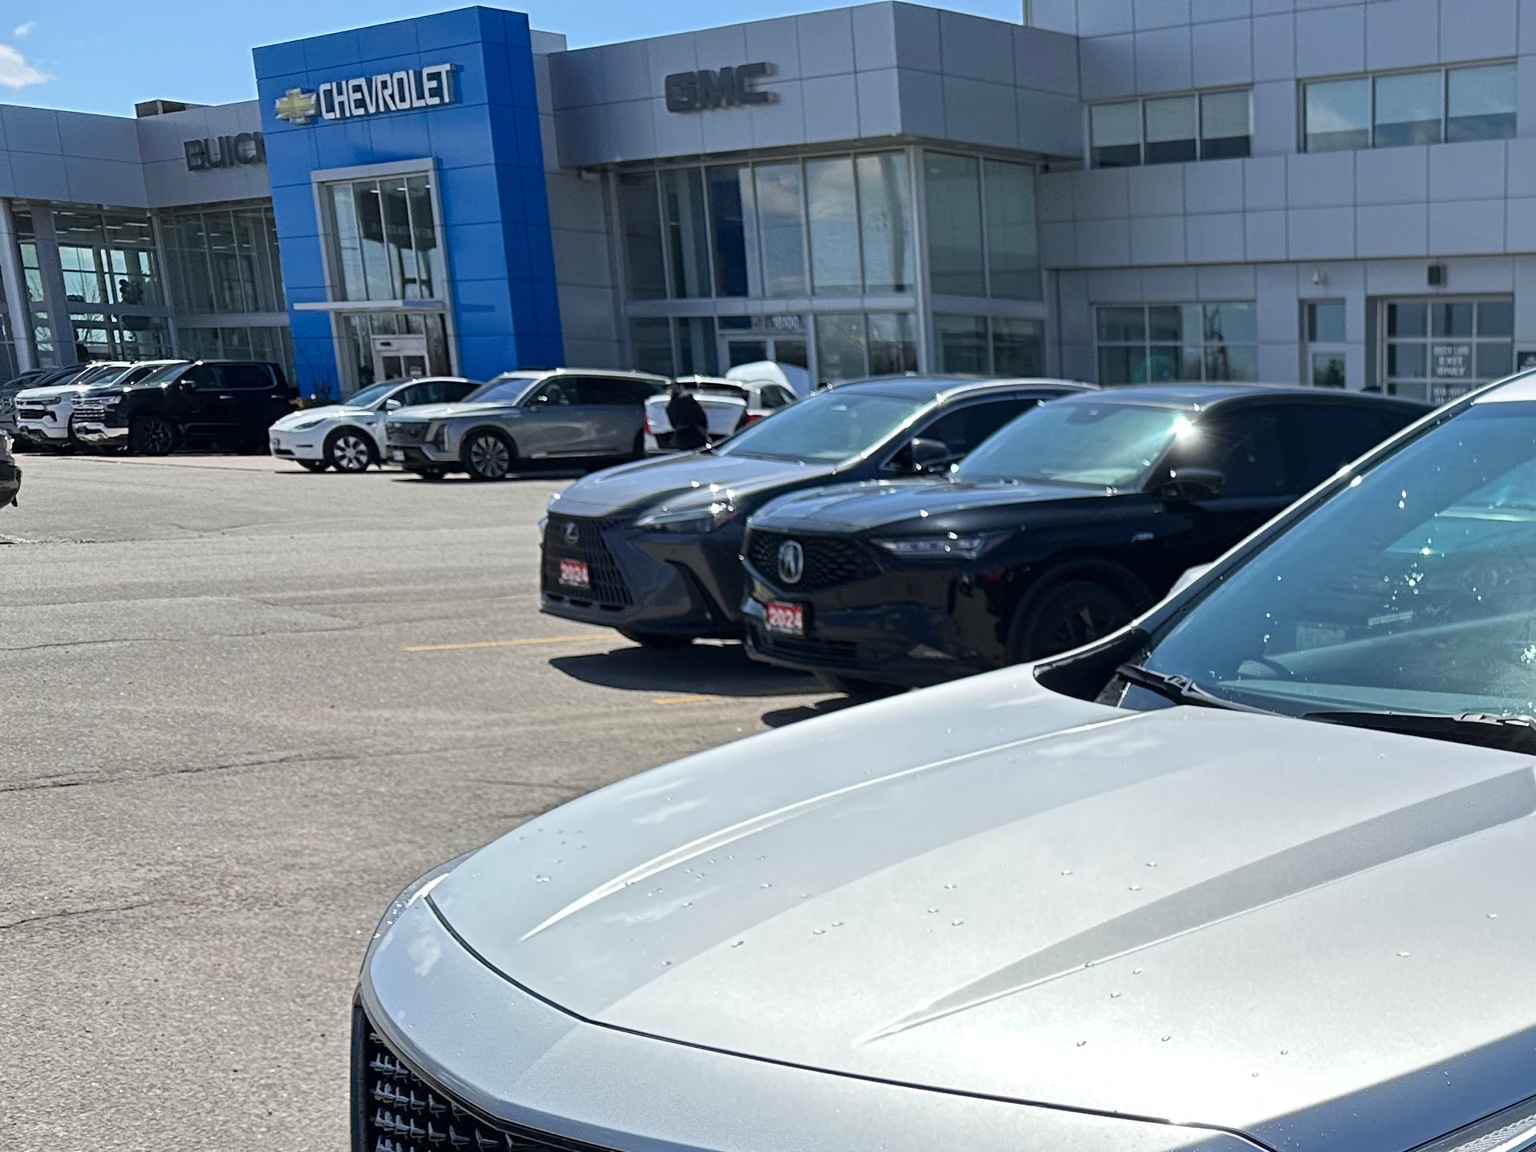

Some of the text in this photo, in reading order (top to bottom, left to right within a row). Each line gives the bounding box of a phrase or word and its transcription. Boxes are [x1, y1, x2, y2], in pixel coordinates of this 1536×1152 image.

[319, 63, 454, 120] CHEVROLET
[664, 62, 778, 113] GMC
[560, 563, 589, 583] 2024
[768, 607, 803, 629] 2024
